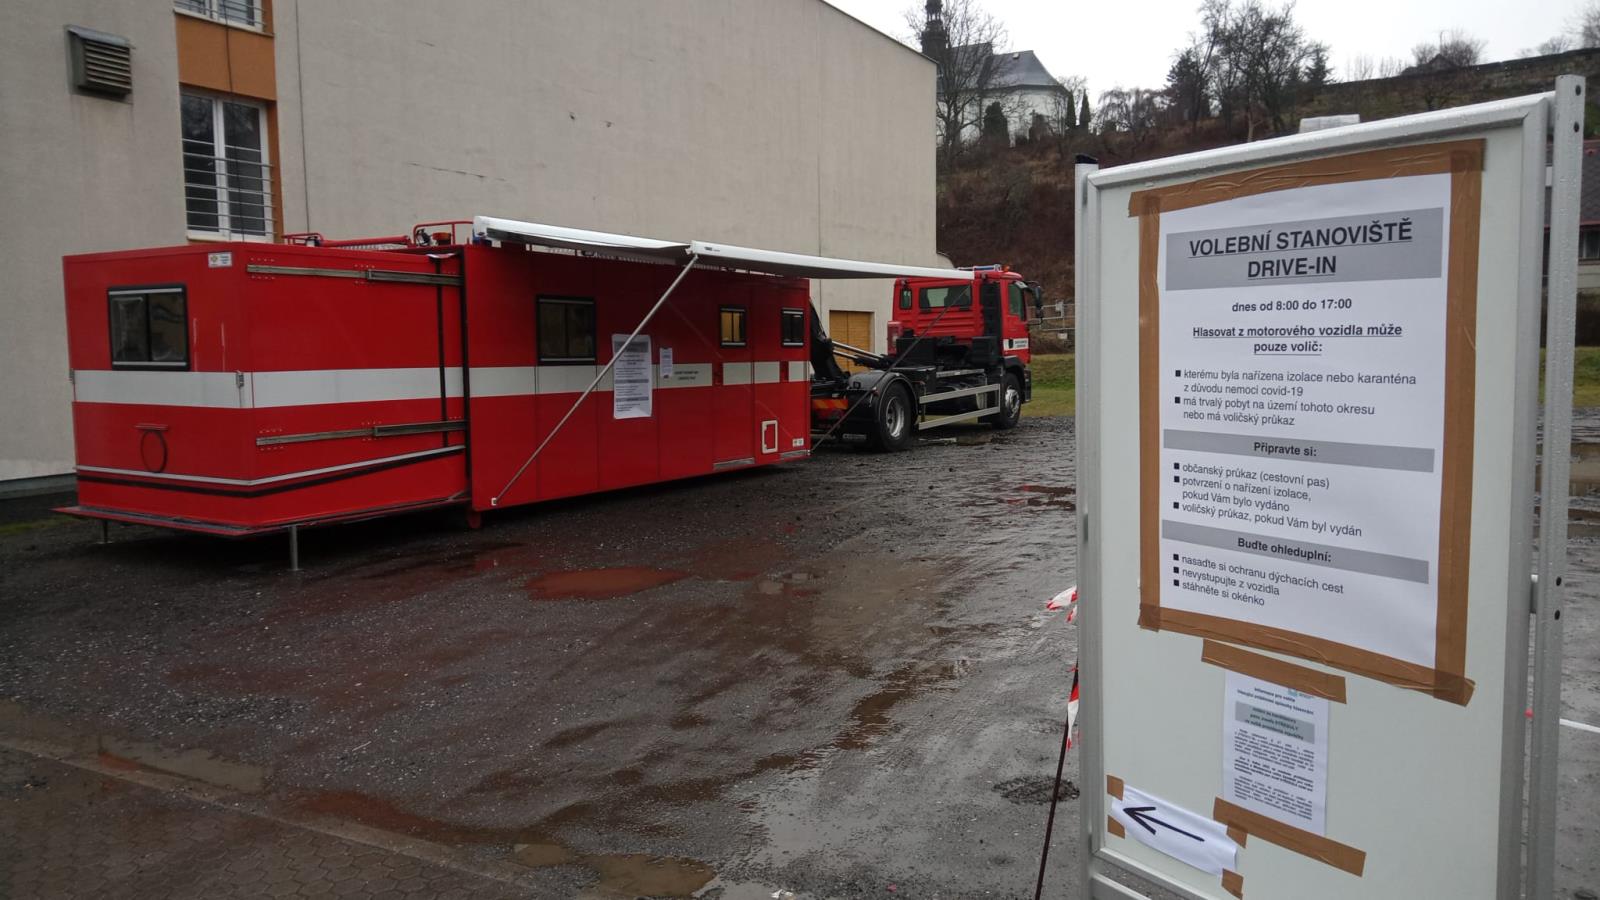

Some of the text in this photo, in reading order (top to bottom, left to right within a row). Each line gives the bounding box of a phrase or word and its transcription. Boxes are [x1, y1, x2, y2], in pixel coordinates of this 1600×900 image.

[1189, 217, 1413, 257] VOLEBNÍ STANOVIŠTĚ
[1247, 256, 1337, 279] DRIVE-IN
[1231, 298, 1352, 312] dnes od 8:00 do 17:00
[1192, 323, 1402, 338] Hlasovat z motorového vozidla může
[1254, 341, 1323, 355] pouze volič:
[1183, 368, 1417, 384] kterému byla nařízena izolace nebo karanténa
[1183, 384, 1189, 392] z
[1225, 384, 1259, 394] nemoci
[1261, 386, 1304, 397] covid-19
[1183, 396, 1376, 415] má trvalý pobyt na území tohoto okresu
[1183, 410, 1296, 426] nebo má voličský průkaz
[1253, 441, 1317, 457] Připravte si:
[1182, 463, 1331, 490] občanský průkaz (cestovní pas)
[1182, 477, 1312, 502] potvrzení o nařízení izolace,
[1182, 490, 1290, 512] pokud Vám bylo vydáno
[1182, 503, 1217, 518] voličský
[1254, 513, 1285, 526] pokud
[1286, 515, 1309, 529] Vám
[1311, 519, 1328, 534] byl
[1329, 524, 1363, 537] vydán
[1270, 543, 1332, 563] ohleduplní:
[1182, 568, 1280, 596] nevystupujte z vozidla
[1218, 561, 1227, 571] si
[1228, 564, 1266, 579] ochranu
[1268, 570, 1320, 590] dýchacích
[1321, 582, 1345, 594] cest
[1182, 581, 1266, 607] stáhněte si okénko
